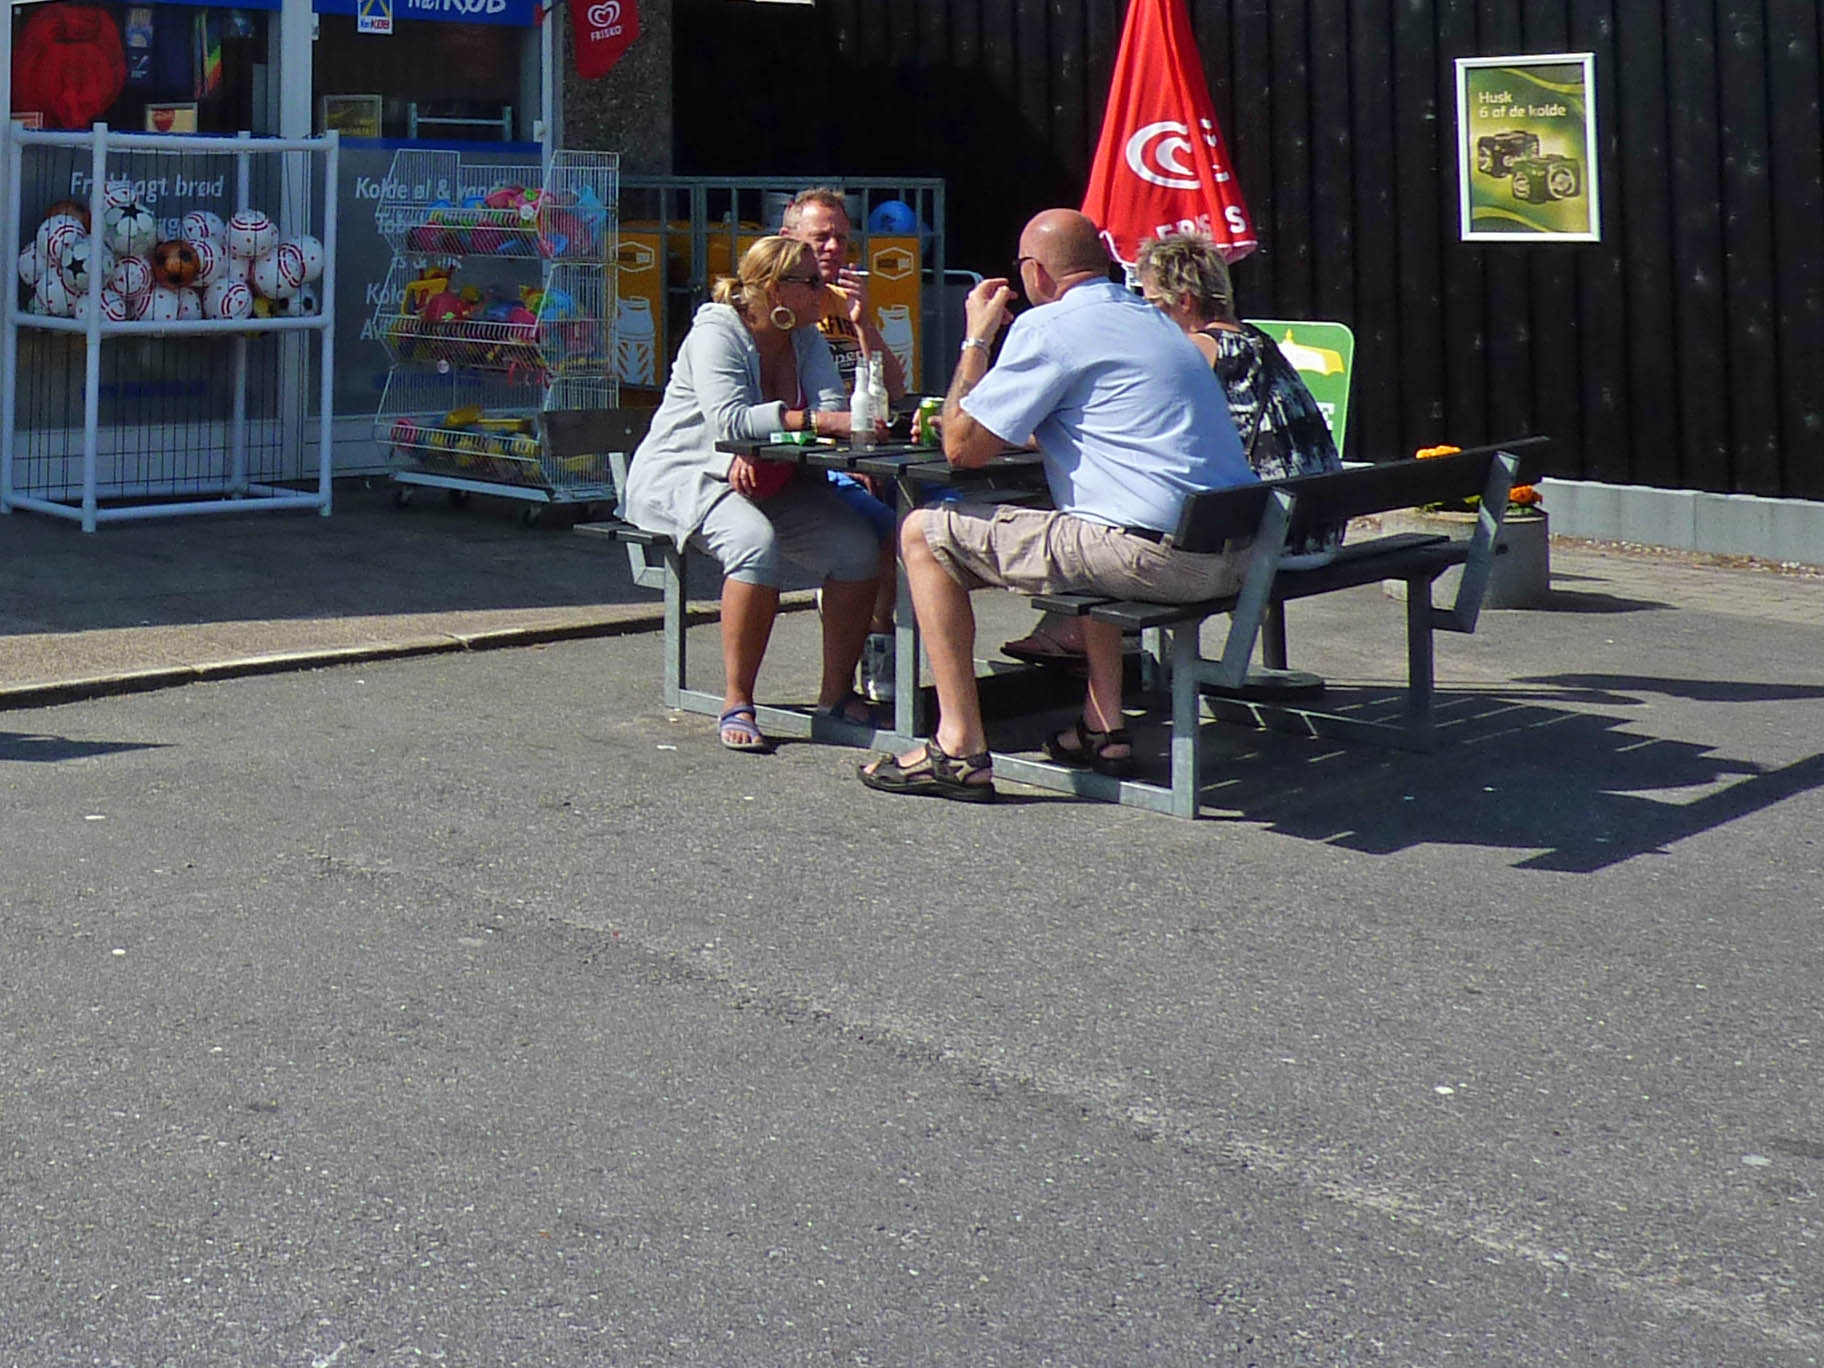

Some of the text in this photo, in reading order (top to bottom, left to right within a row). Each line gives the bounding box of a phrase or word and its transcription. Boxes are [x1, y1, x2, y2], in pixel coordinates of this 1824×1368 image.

[1479, 91, 1512, 104] Husk
[1479, 106, 1488, 118] 6
[1509, 105, 1526, 117] de
[1529, 104, 1567, 117] kolde
[175, 175, 224, 198] brød
[355, 177, 407, 199] Kolde
[437, 179, 450, 199] &
